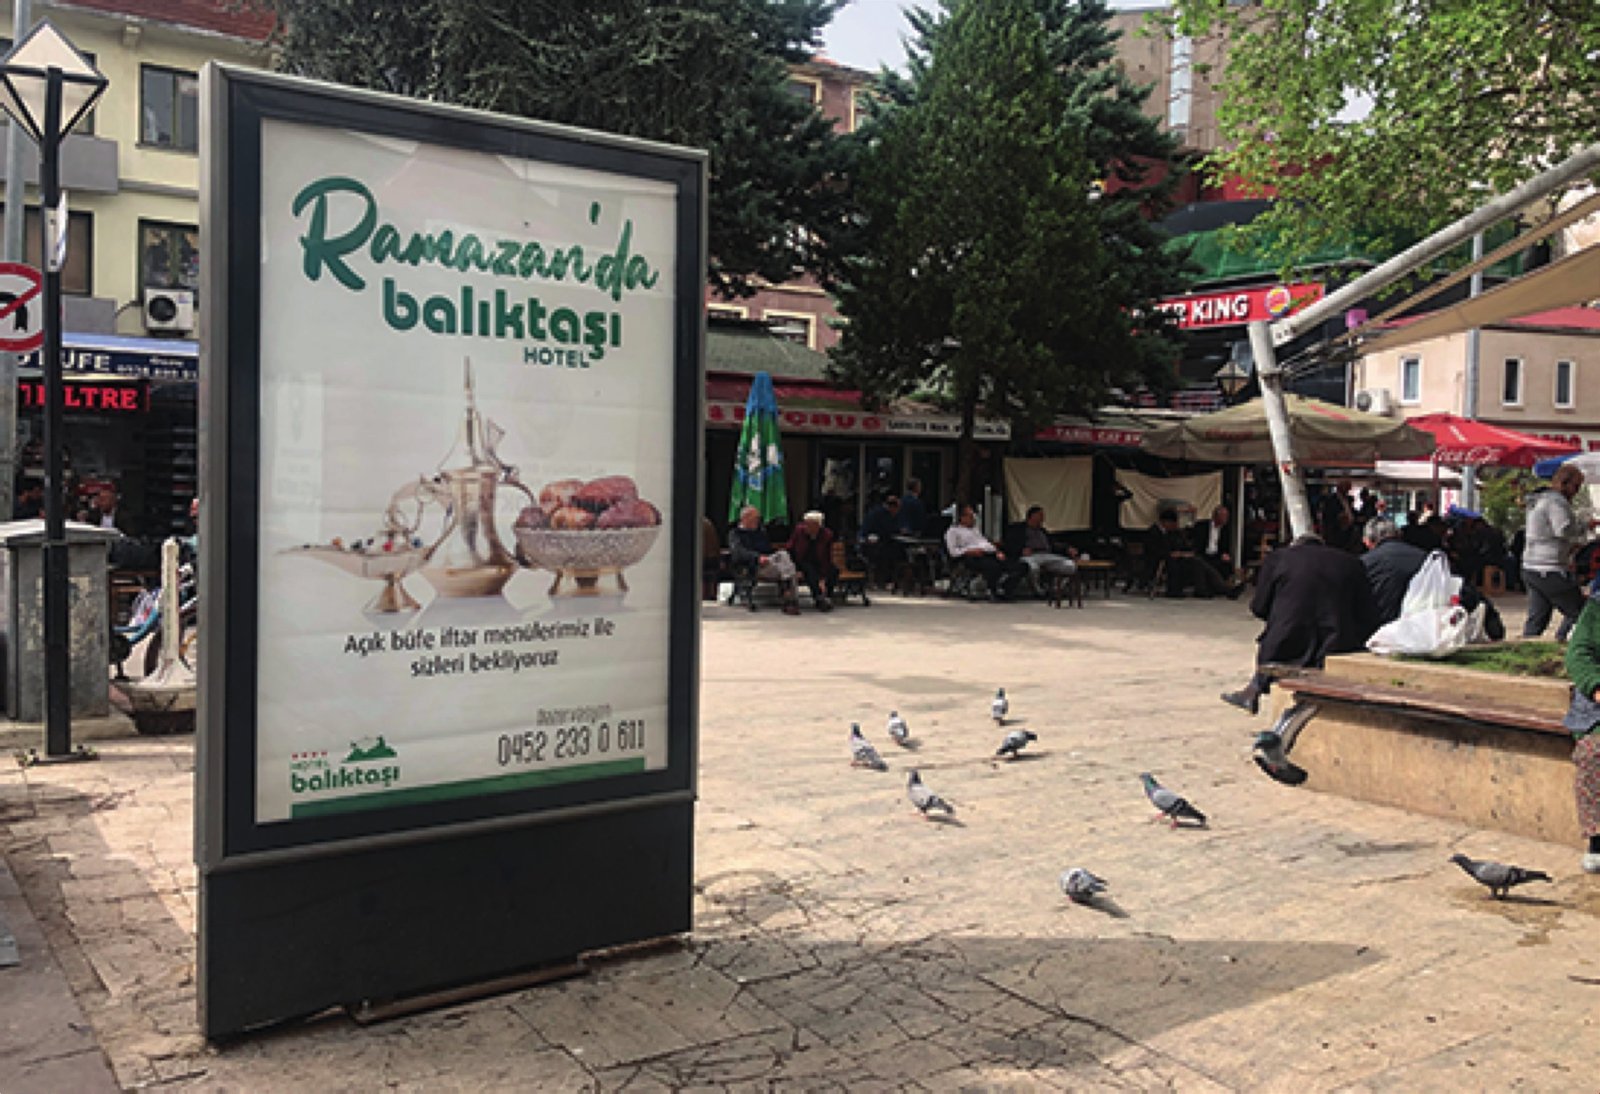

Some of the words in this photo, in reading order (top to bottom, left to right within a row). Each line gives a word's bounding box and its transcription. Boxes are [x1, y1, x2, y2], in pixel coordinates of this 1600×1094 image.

[292, 176, 659, 301] Ramazan'da
[382, 277, 622, 360] balıktaşı
[1191, 294, 1248, 322] KING
[524, 347, 590, 368] HOTEL
[344, 632, 386, 655] Açık
[391, 629, 434, 651] büfe
[440, 627, 478, 648] iftar
[484, 619, 589, 643] menülerimiz
[595, 617, 616, 636] ile
[411, 654, 464, 677] sizleri
[470, 650, 559, 673] bekliyoruz
[498, 731, 547, 766] 0452
[554, 726, 591, 758] 233
[598, 722, 610, 753] 0
[618, 719, 645, 750] 611
[291, 766, 400, 793] balıktaşı
